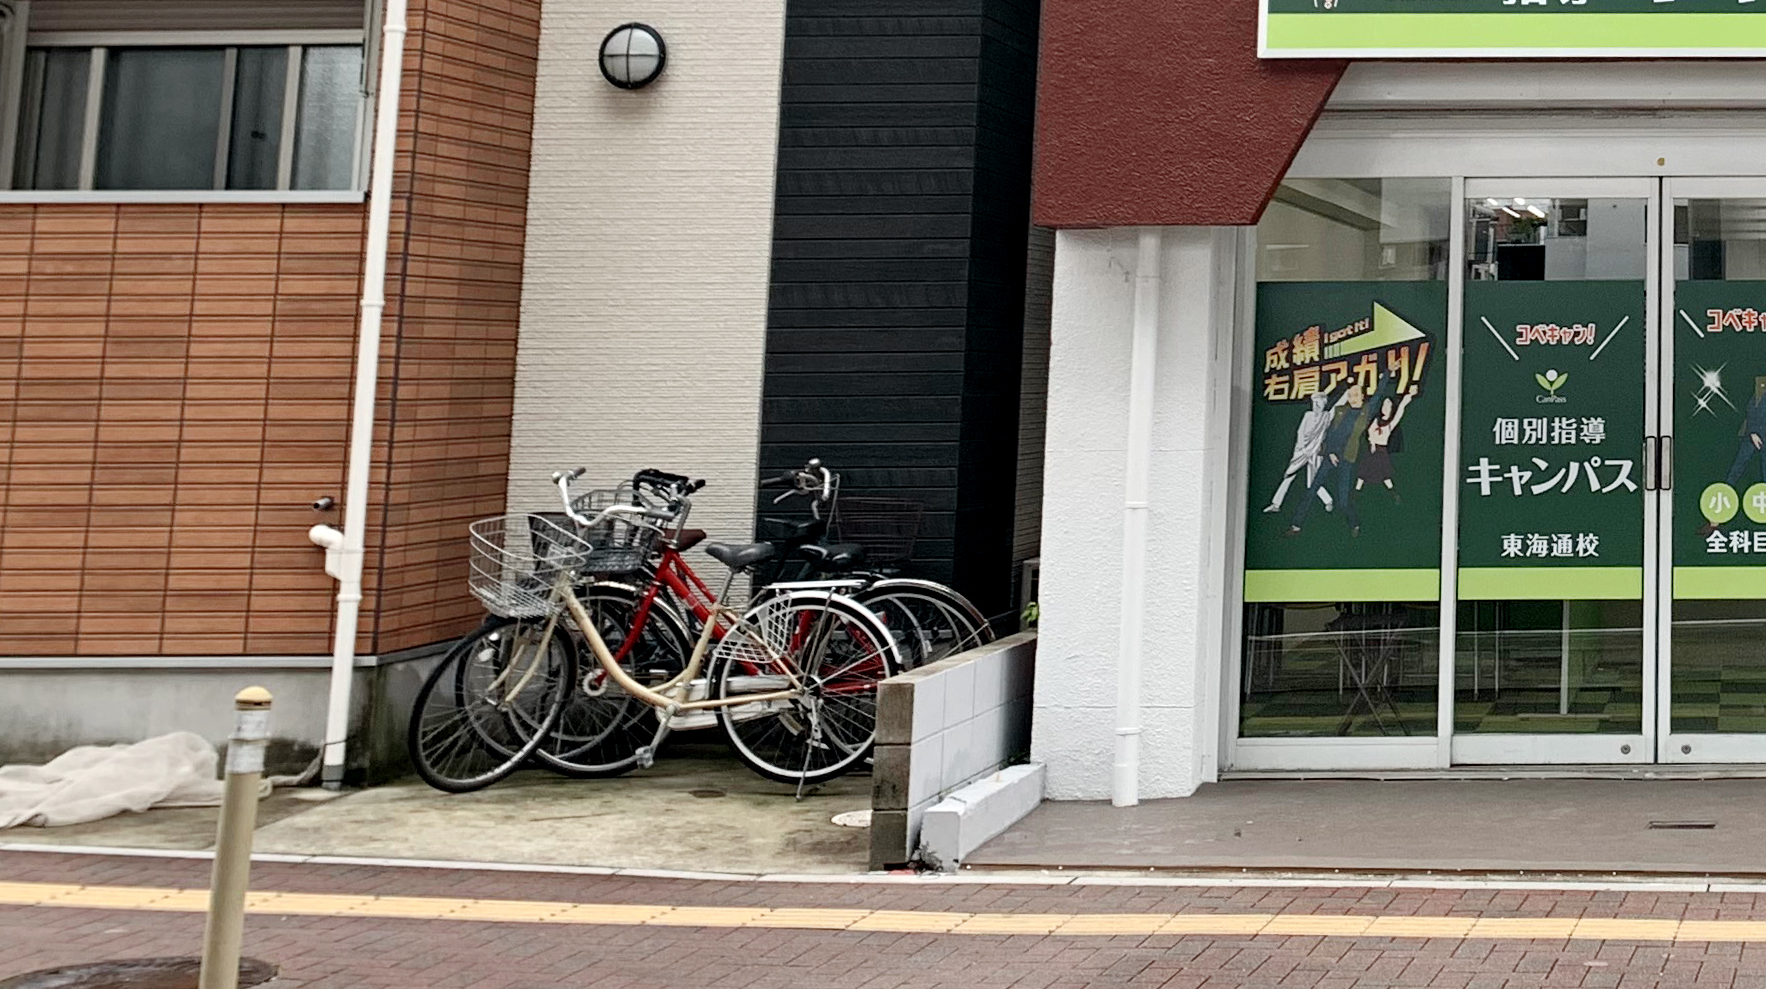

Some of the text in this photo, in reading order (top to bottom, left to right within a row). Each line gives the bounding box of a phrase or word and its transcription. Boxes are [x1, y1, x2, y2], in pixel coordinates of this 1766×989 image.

[1264, 325, 1320, 373] 成績
[1535, 393, 1567, 404] CanPass
[1492, 416, 1607, 446] 個別指導
[1466, 457, 1638, 497] キャンパス
[1500, 533, 1600, 558] 東海通校
